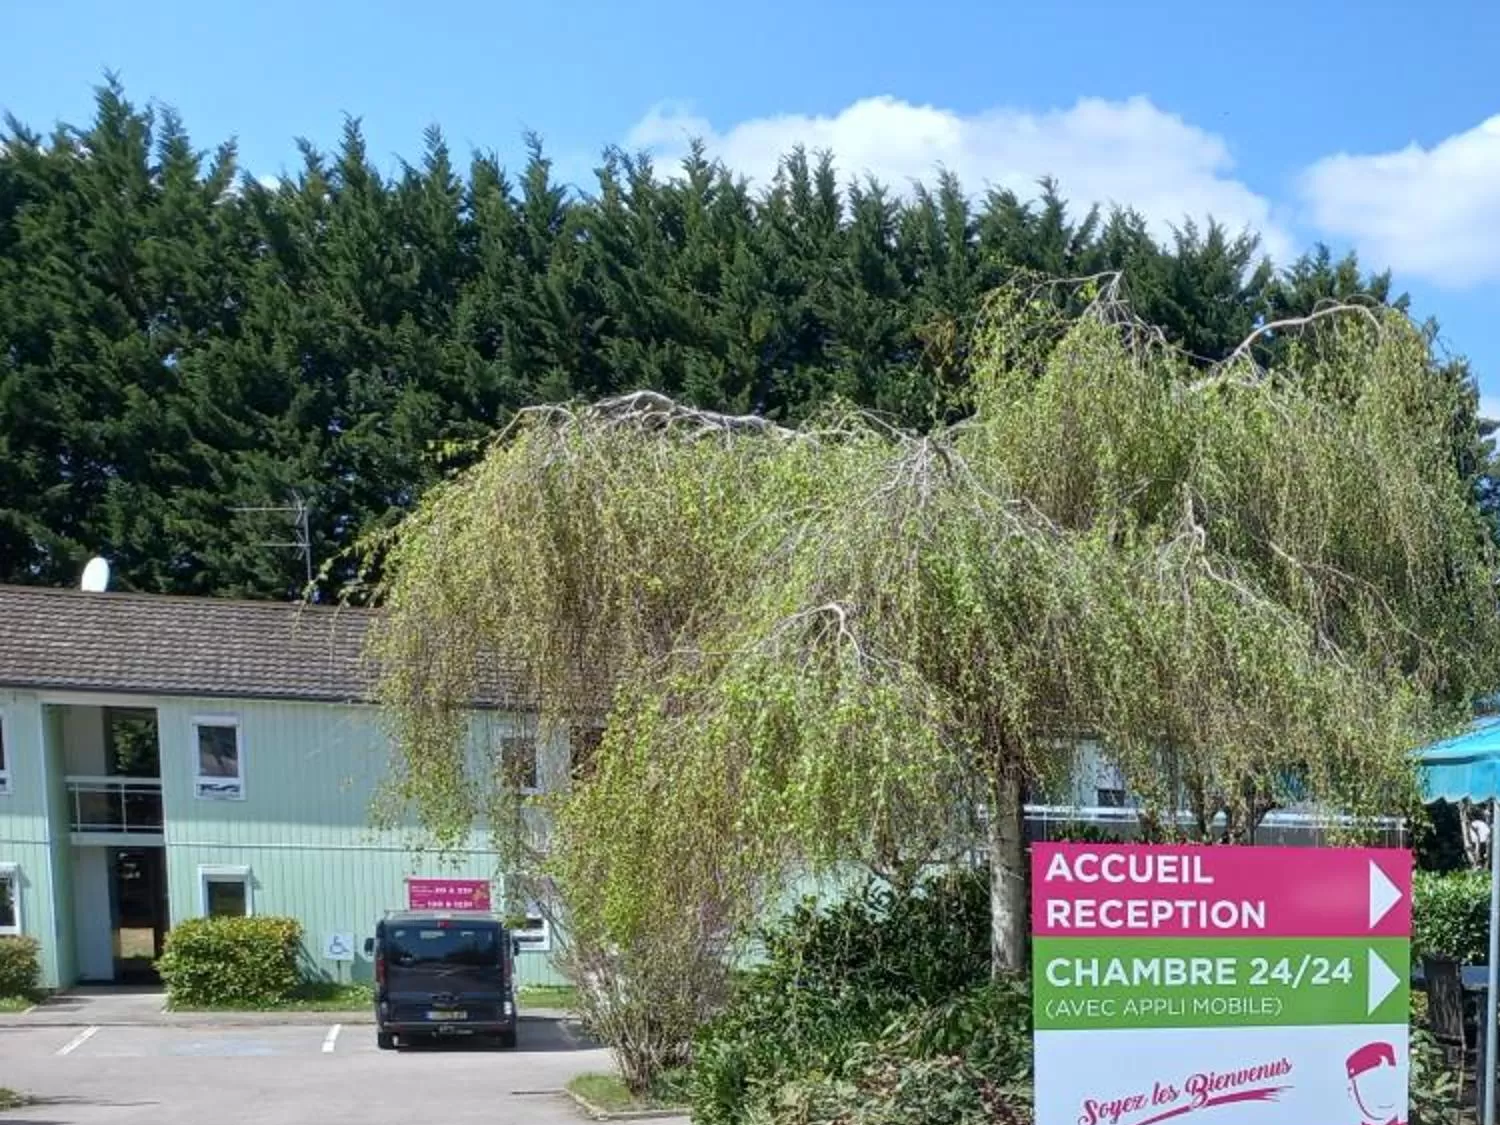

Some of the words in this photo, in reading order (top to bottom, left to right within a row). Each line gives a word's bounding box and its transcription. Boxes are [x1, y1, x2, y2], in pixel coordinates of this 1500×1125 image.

[1044, 852, 1215, 885] ACCUEIL
[1046, 899, 1266, 929] RECEPTION
[1045, 956, 1237, 987] CHAMBRE
[1249, 954, 1353, 989] 24/24
[1045, 998, 1117, 1019] (AVEC
[1123, 998, 1186, 1017] APPLI
[1192, 996, 1284, 1017] MOBILE)
[1151, 1080, 1181, 1107] les
[1184, 1056, 1293, 1109] Bienvenus
